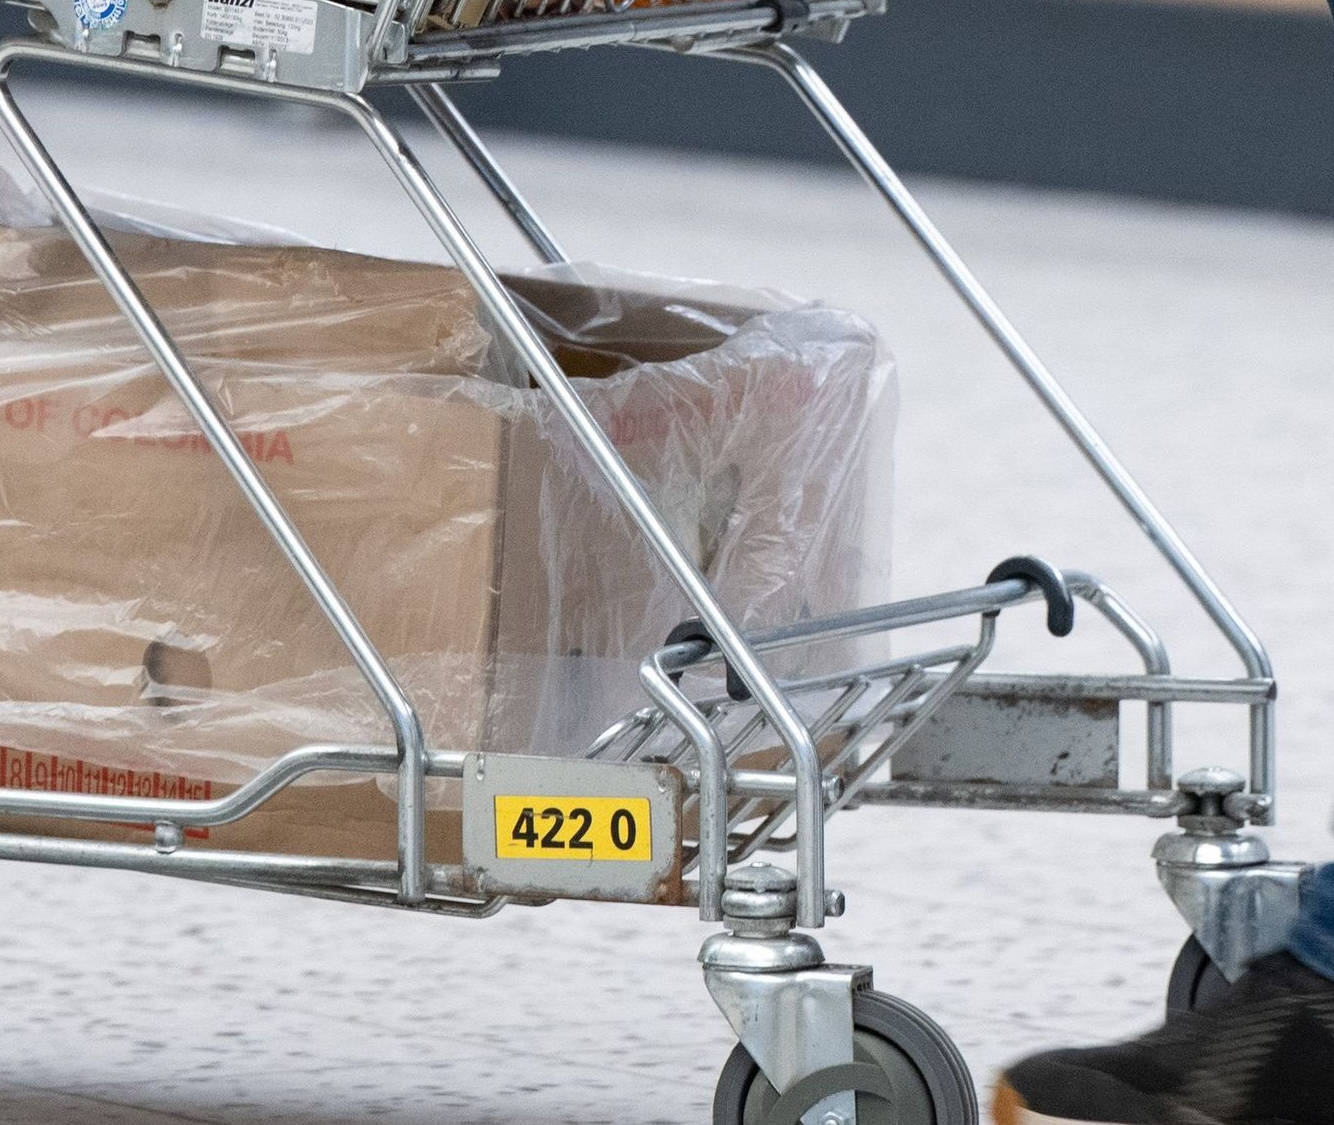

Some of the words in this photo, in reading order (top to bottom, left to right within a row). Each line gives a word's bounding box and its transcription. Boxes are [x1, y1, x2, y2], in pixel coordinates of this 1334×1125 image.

[10, 757, 23, 788] 8
[35, 761, 48, 789] 9
[511, 807, 594, 849] 422
[610, 808, 637, 851] 0
